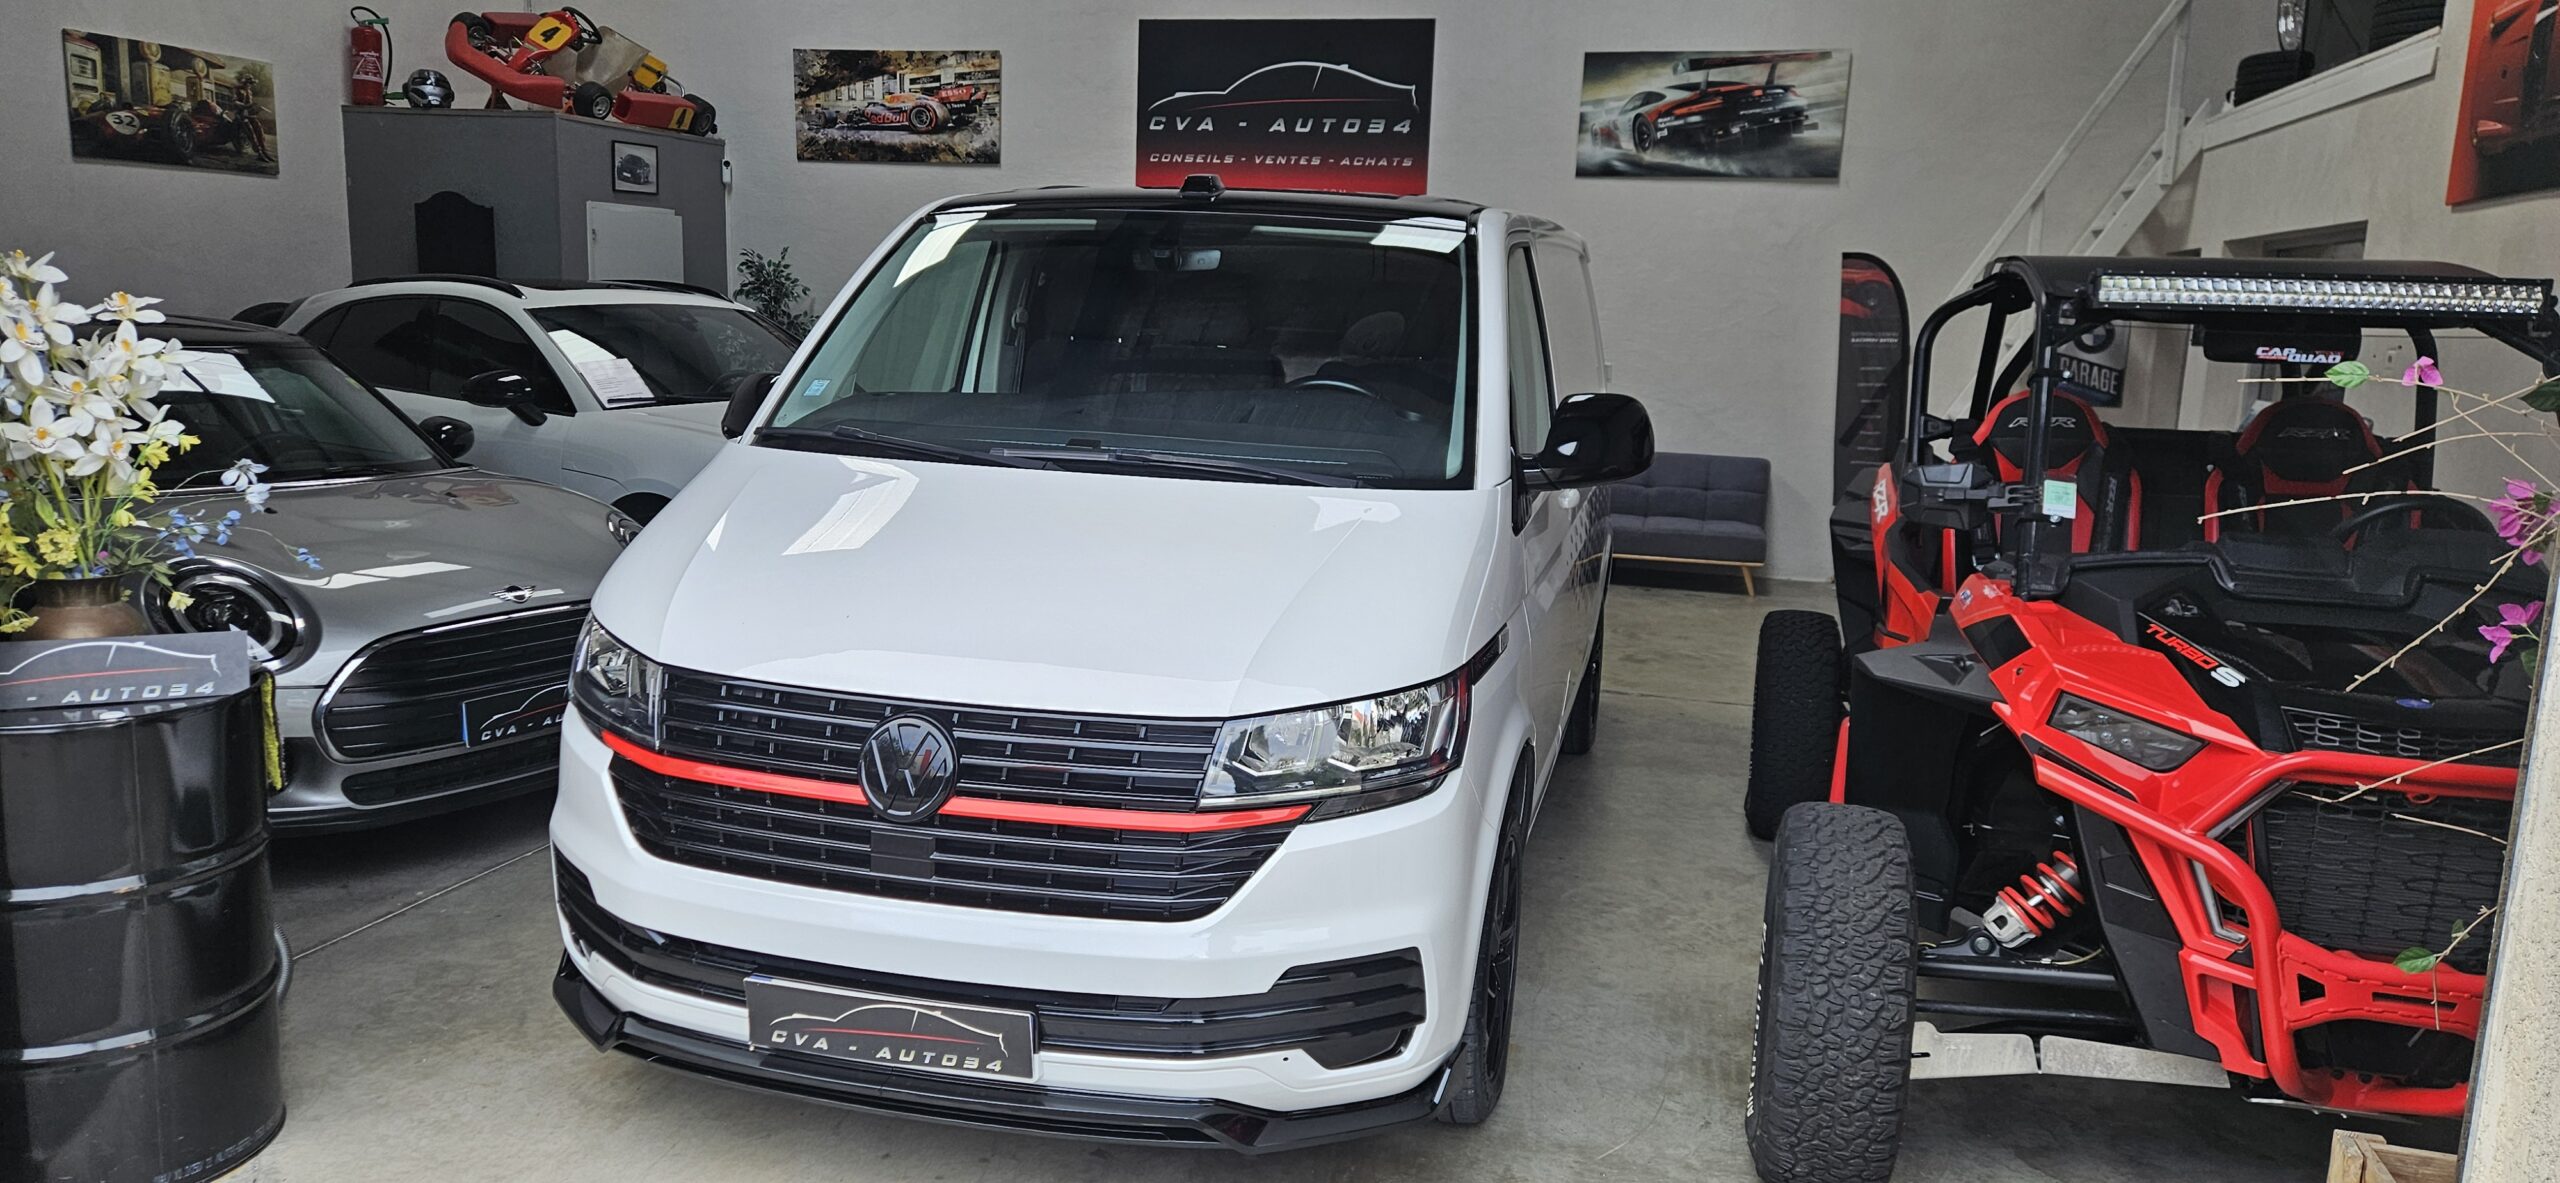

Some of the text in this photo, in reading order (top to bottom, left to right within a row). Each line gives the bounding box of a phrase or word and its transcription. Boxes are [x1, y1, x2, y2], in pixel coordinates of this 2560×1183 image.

[539, 26, 561, 43] 4
[111, 114, 138, 129] 32
[675, 108, 689, 129] 4
[1149, 116, 1214, 131] CVA
[1269, 118, 1412, 134] AUTO34
[1150, 153, 1235, 164] CONSEILS
[1254, 155, 1322, 165] VENTES
[1340, 156, 1414, 167] ACHATS
[2256, 346, 2297, 358] CAR
[2287, 353, 2342, 363] QUAD
[2146, 623, 2246, 688] TURBO S
[61, 682, 215, 704] AUTO34
[481, 725, 517, 741] CVA
[771, 1029, 829, 1051] CVA
[876, 1047, 1002, 1072] AUTO34
